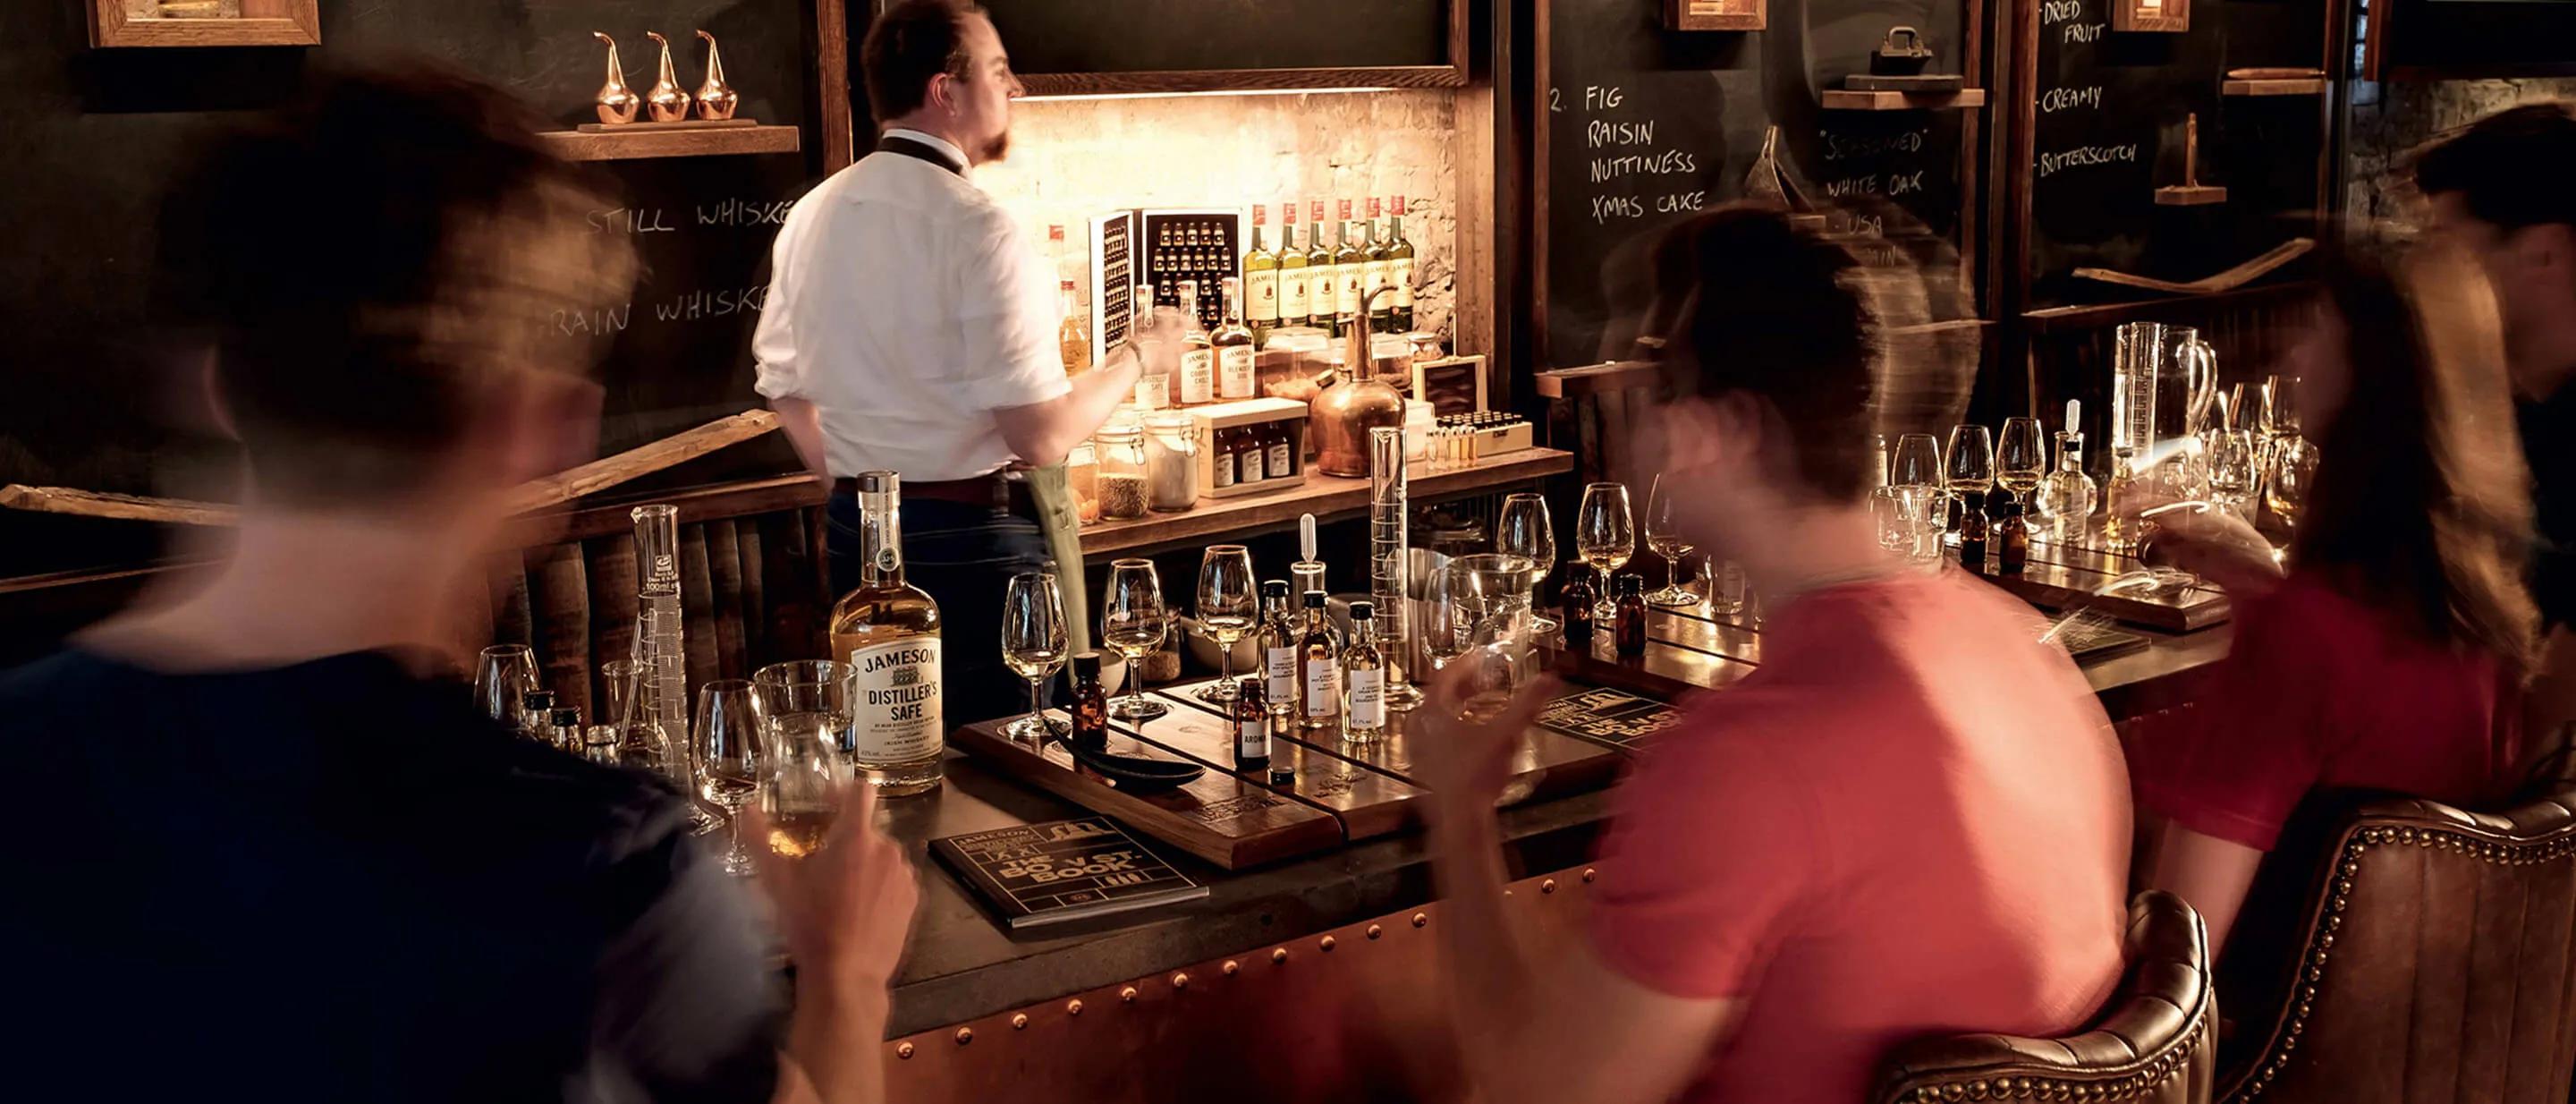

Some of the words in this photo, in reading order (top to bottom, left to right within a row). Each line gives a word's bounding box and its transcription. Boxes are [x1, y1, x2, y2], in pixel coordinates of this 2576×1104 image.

[2064, 23, 2106, 43] FRUIT
[1586, 86, 1623, 112] FIG
[1588, 119, 1654, 149] RAISIN
[1590, 149, 1697, 183] NUTTINESS
[1827, 174, 1877, 197] WHITE
[1889, 170, 1923, 196] OAK
[585, 208, 675, 234] STILL
[697, 198, 793, 226] WHISKE
[1592, 195, 1644, 225] XMAS
[1657, 191, 1705, 212] CAKE
[538, 303, 631, 336] RAIN
[657, 285, 768, 321] WHISKE
[865, 648, 936, 674] JAMESON
[869, 681, 937, 705] DISTILLER'S
[891, 702, 922, 721] SAFE
[1030, 859, 1136, 883] BOOK
